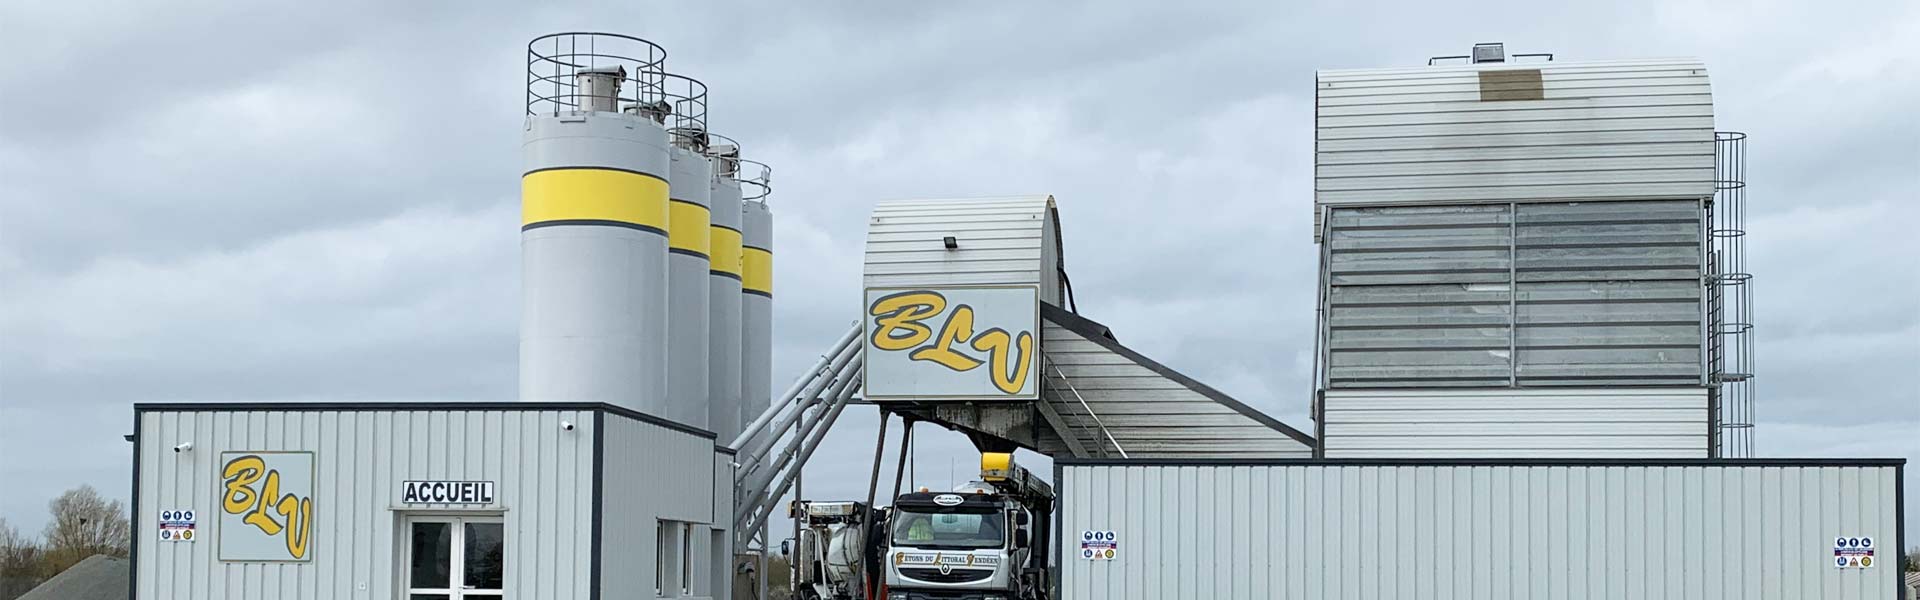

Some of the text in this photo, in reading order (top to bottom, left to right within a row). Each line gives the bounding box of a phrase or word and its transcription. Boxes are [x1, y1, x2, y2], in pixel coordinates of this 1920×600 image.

[869, 290, 1033, 394] BLV
[222, 455, 311, 559] BLV
[404, 482, 492, 502] ACCUEIL
[925, 555, 934, 563] DU
[933, 552, 966, 566] LITTORAL
